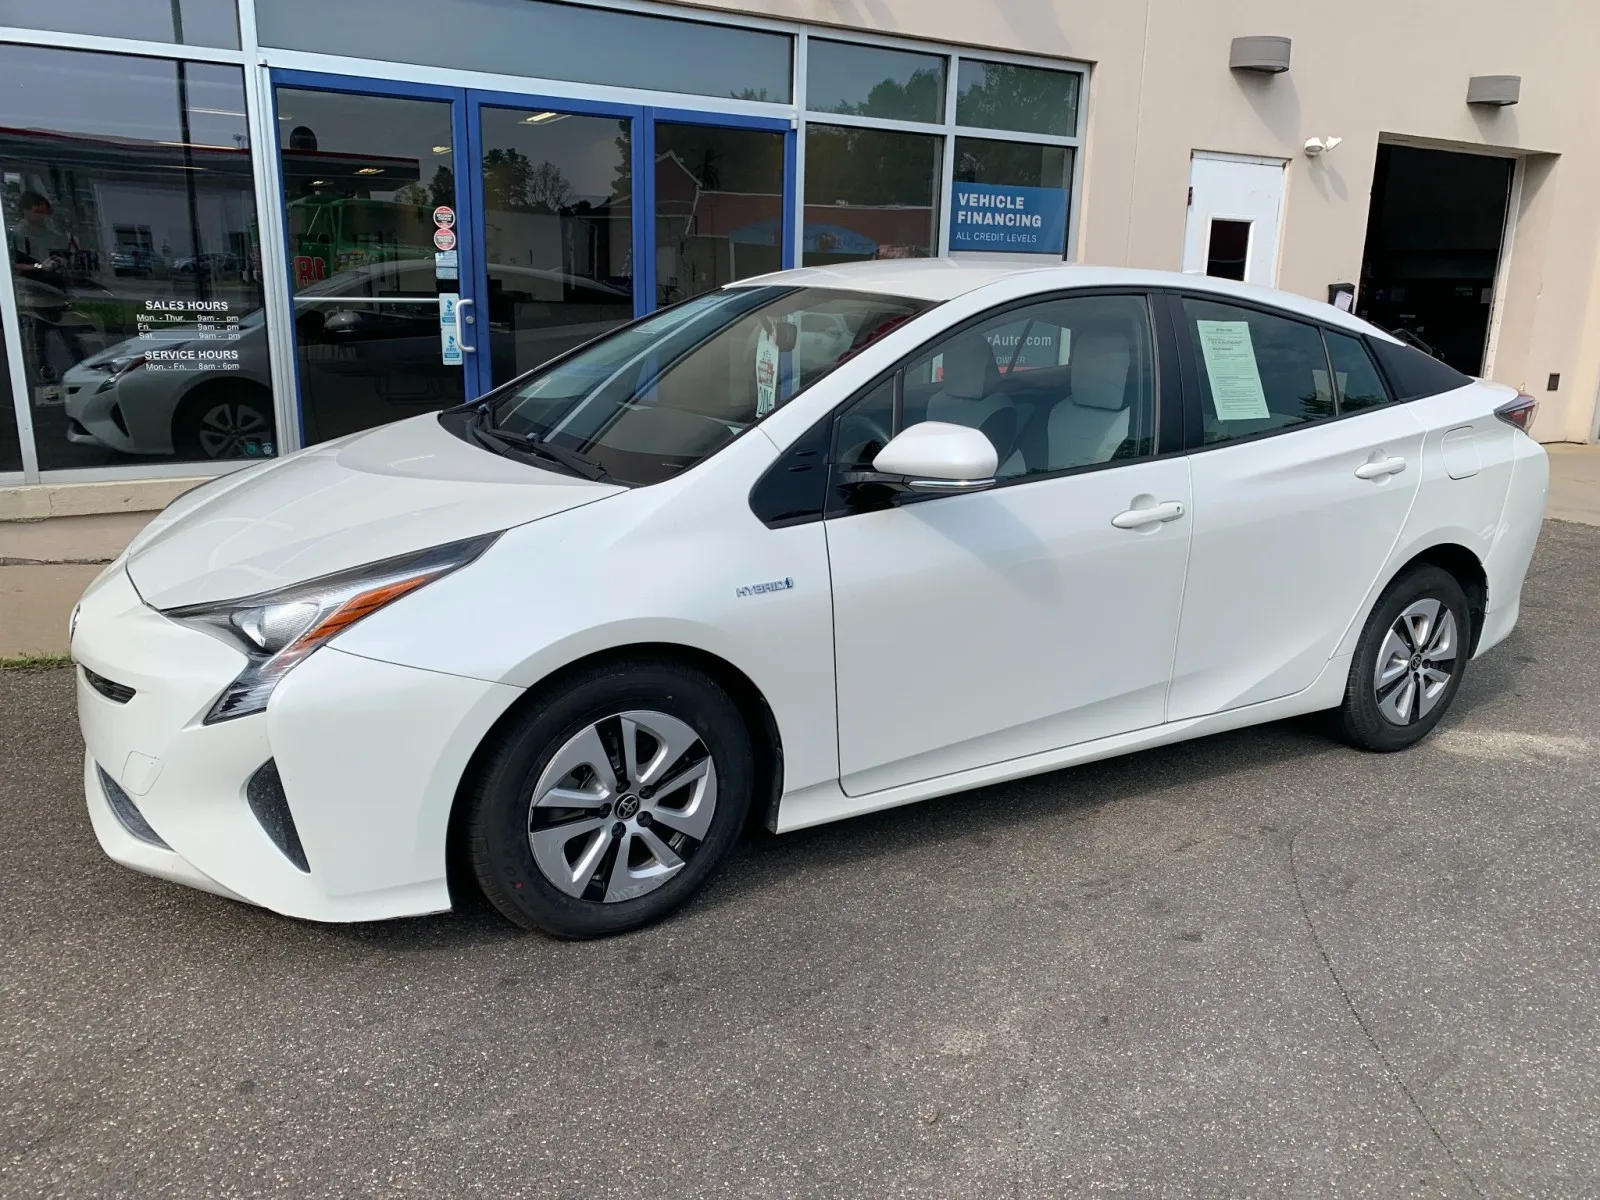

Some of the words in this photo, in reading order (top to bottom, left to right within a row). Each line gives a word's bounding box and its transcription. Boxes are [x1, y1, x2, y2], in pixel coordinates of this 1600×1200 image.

[958, 192, 1025, 210] VEHICLE
[957, 210, 1041, 228] FINANCING
[955, 231, 971, 241] ALL
[973, 232, 1005, 242] CREDIT
[1006, 233, 1037, 243] LEVELS
[145, 300, 185, 310] SALES
[187, 301, 229, 311] HOURS
[164, 313, 186, 322] Thur.
[137, 323, 151, 331] Fri.
[197, 323, 215, 331] 9am
[198, 332, 217, 340] 9am
[228, 333, 241, 341] pm
[144, 350, 196, 360] SERVICE
[198, 350, 239, 360] HOURS
[173, 363, 187, 371] Fri.
[198, 363, 216, 371] 8am
[222, 363, 240, 371] 6pm
[735, 580, 784, 598] HYBRID
